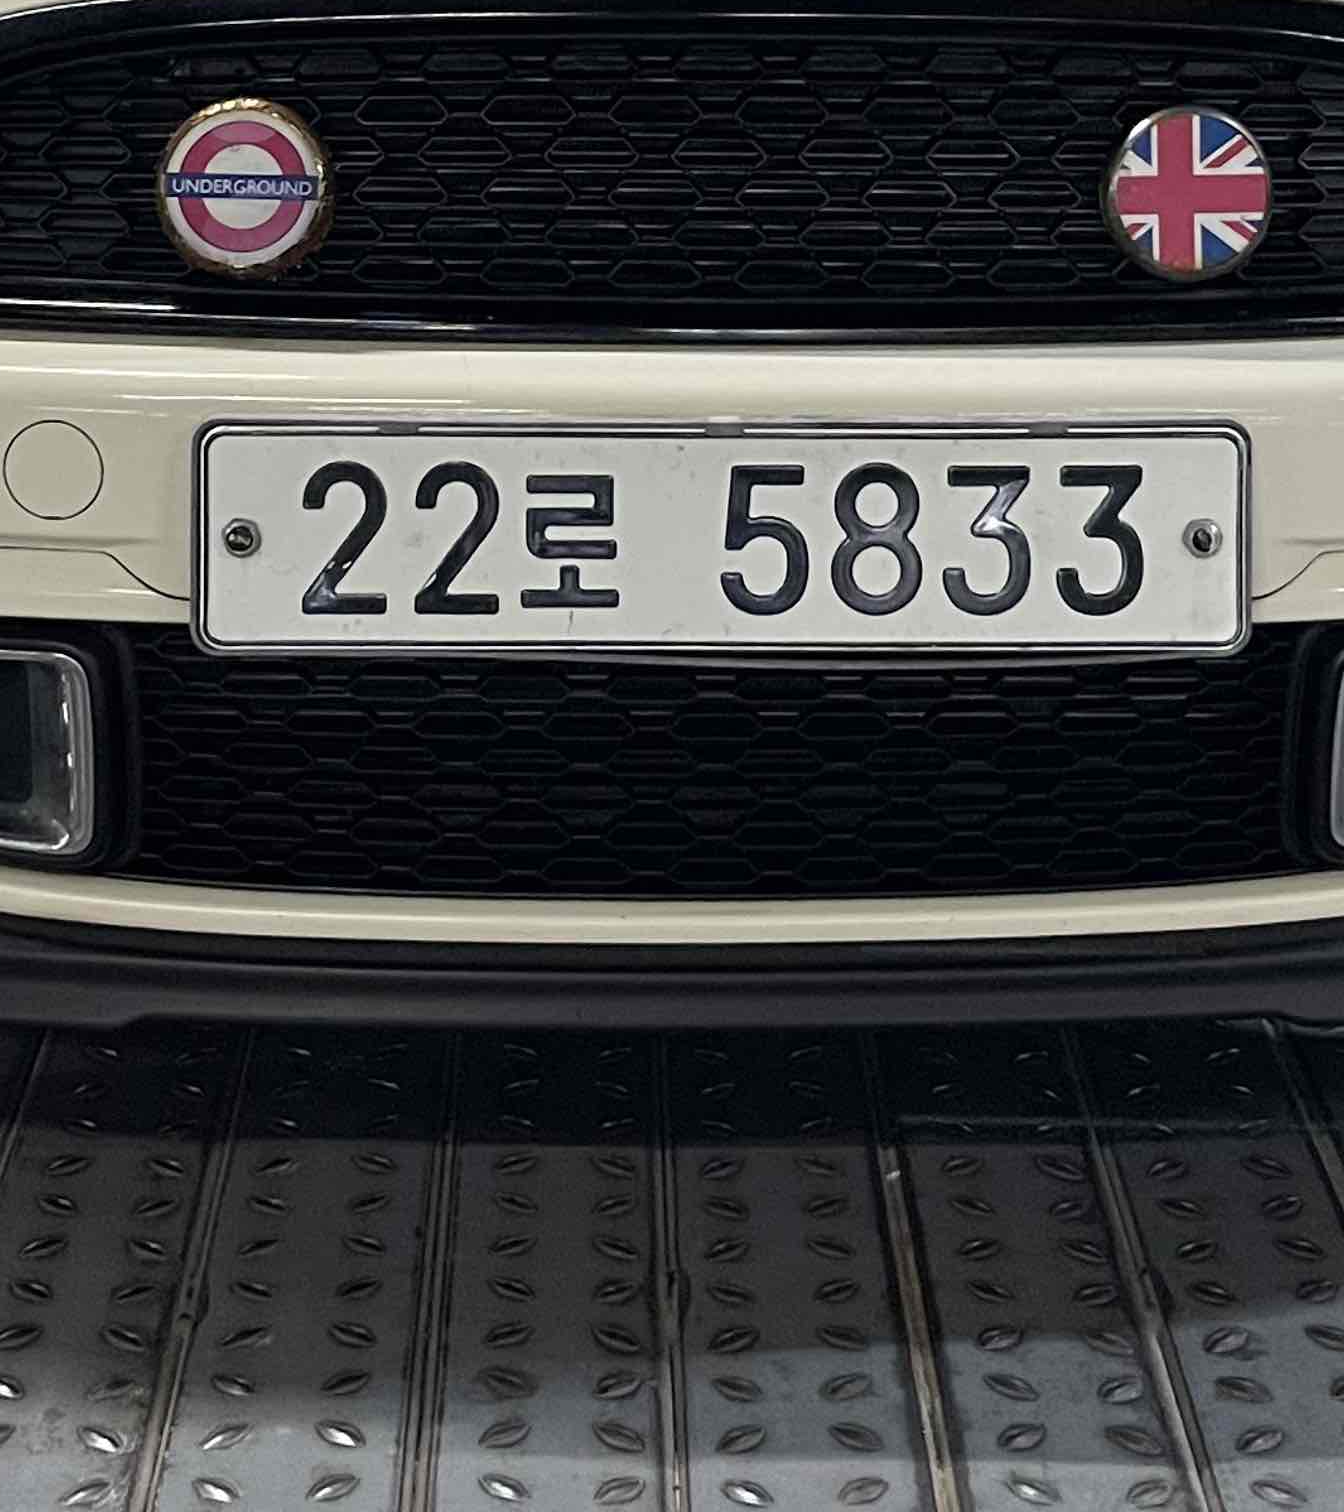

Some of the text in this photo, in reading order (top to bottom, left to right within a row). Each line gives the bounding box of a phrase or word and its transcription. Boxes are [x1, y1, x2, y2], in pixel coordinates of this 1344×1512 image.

[171, 178, 313, 196] UNDERGROUND
[301, 460, 1144, 616] 22로 5833
